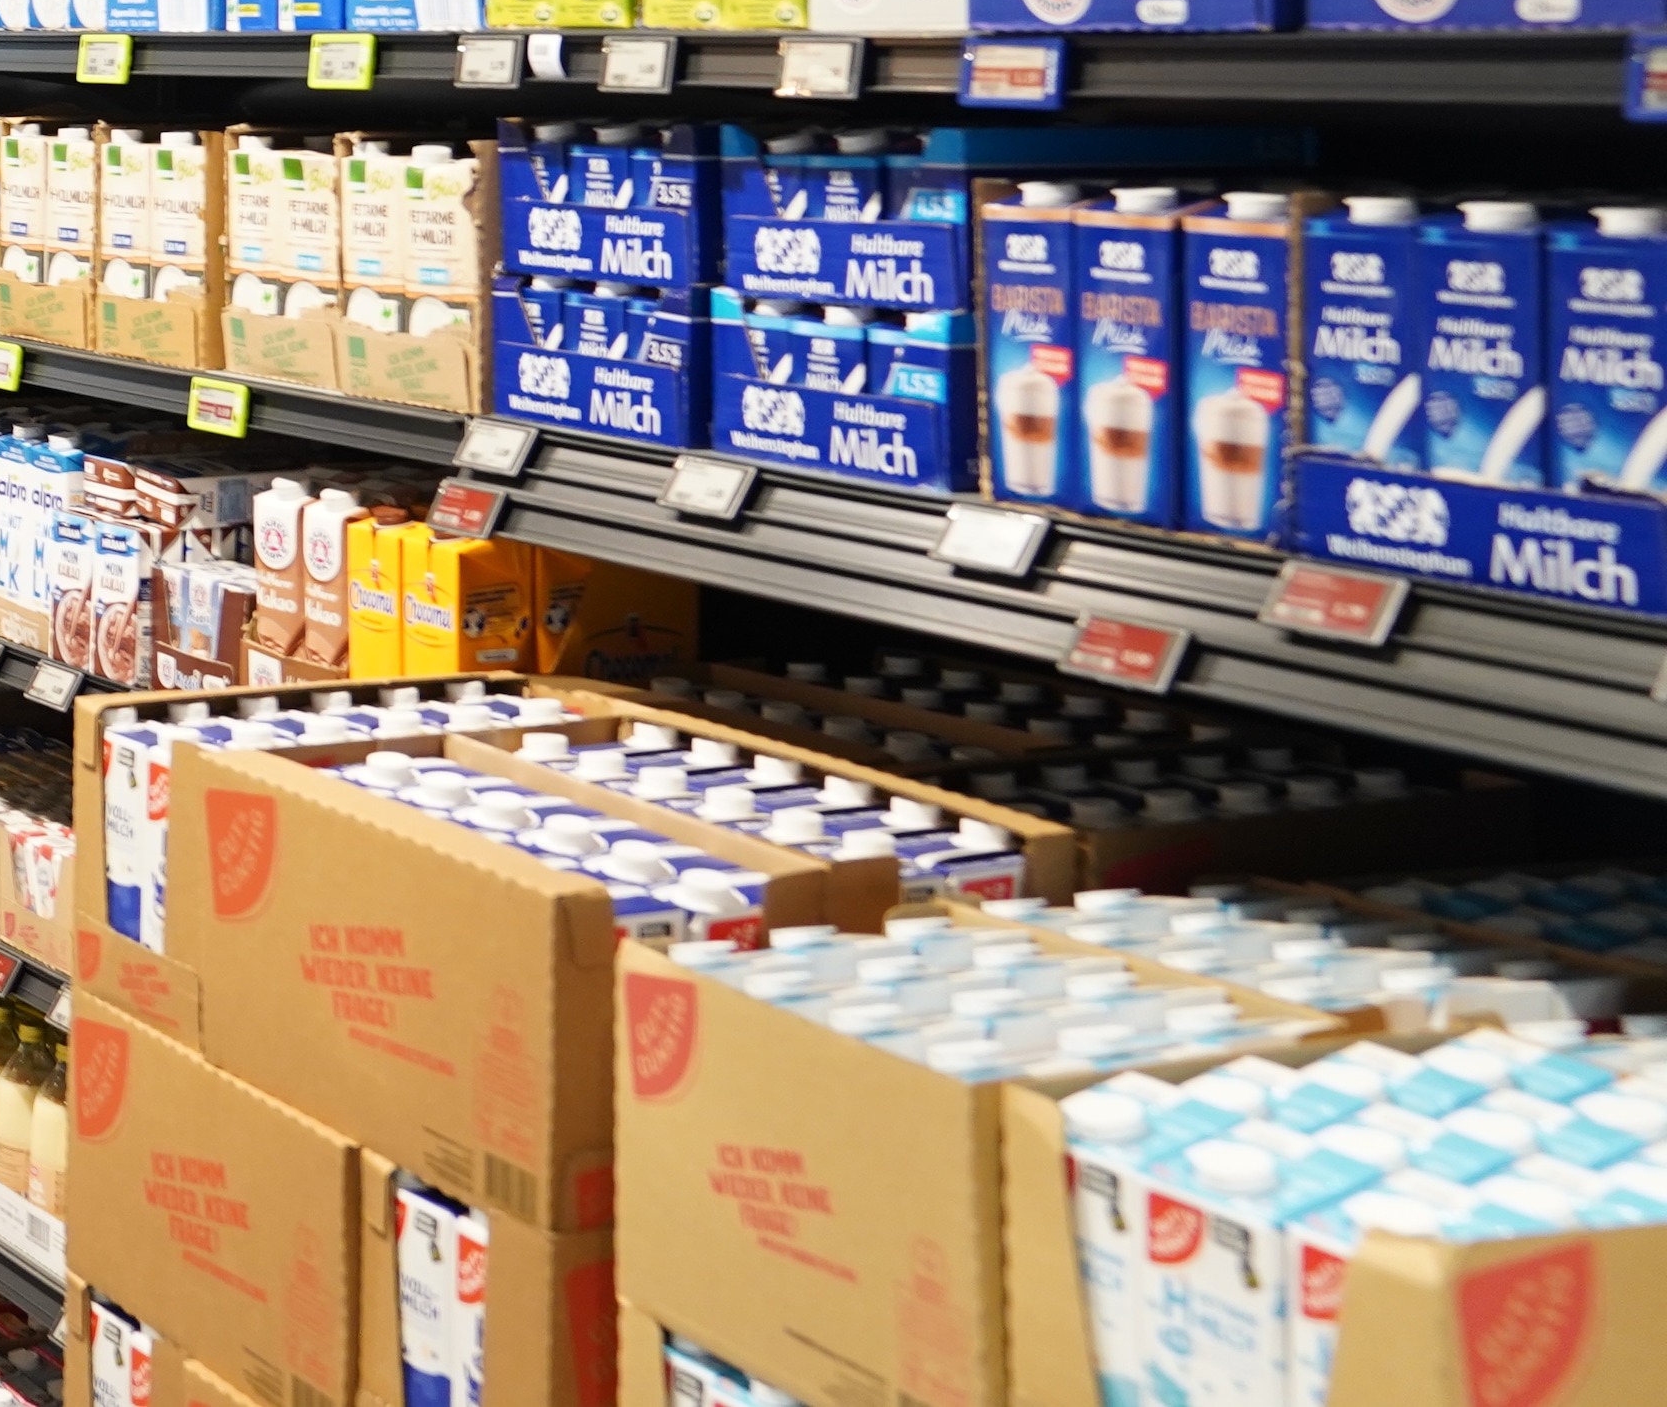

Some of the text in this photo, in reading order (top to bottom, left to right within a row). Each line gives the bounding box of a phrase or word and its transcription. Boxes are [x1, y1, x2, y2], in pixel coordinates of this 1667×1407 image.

[605, 215, 664, 238] Haltbare
[600, 238, 672, 281] Milch
[851, 234, 924, 257] Haltbare
[846, 258, 934, 304] Milch
[991, 286, 1065, 314] BARISTA
[1082, 294, 1162, 326] BARISTA
[1190, 303, 1277, 335] BARISTA
[1314, 326, 1400, 363] Milch
[1430, 338, 1522, 376] Milch
[595, 367, 654, 392] Haltbare
[1561, 349, 1662, 388] Milch
[589, 390, 662, 436] Milch
[834, 401, 906, 430] Haltbare
[829, 425, 917, 478] Milch
[31, 484, 63, 511] alpro
[7, 516, 22, 529] NOT
[1498, 504, 1620, 543] Haltbare
[61, 549, 78, 564] MOIN
[105, 563, 123, 576] MOIN
[1490, 533, 1637, 605] Milch
[305, 598, 342, 627] Kakao
[349, 581, 395, 614] Chocomel
[403, 592, 452, 630] Chocomel
[107, 802, 134, 820] VOLL-
[106, 819, 133, 837] MILCH
[310, 925, 405, 956] ICH KOMM
[152, 1152, 226, 1189] ICH KOMM
[717, 1144, 803, 1174] ICH KOMM
[401, 1274, 435, 1297] VOLL-
[400, 1291, 439, 1319] MILCH
